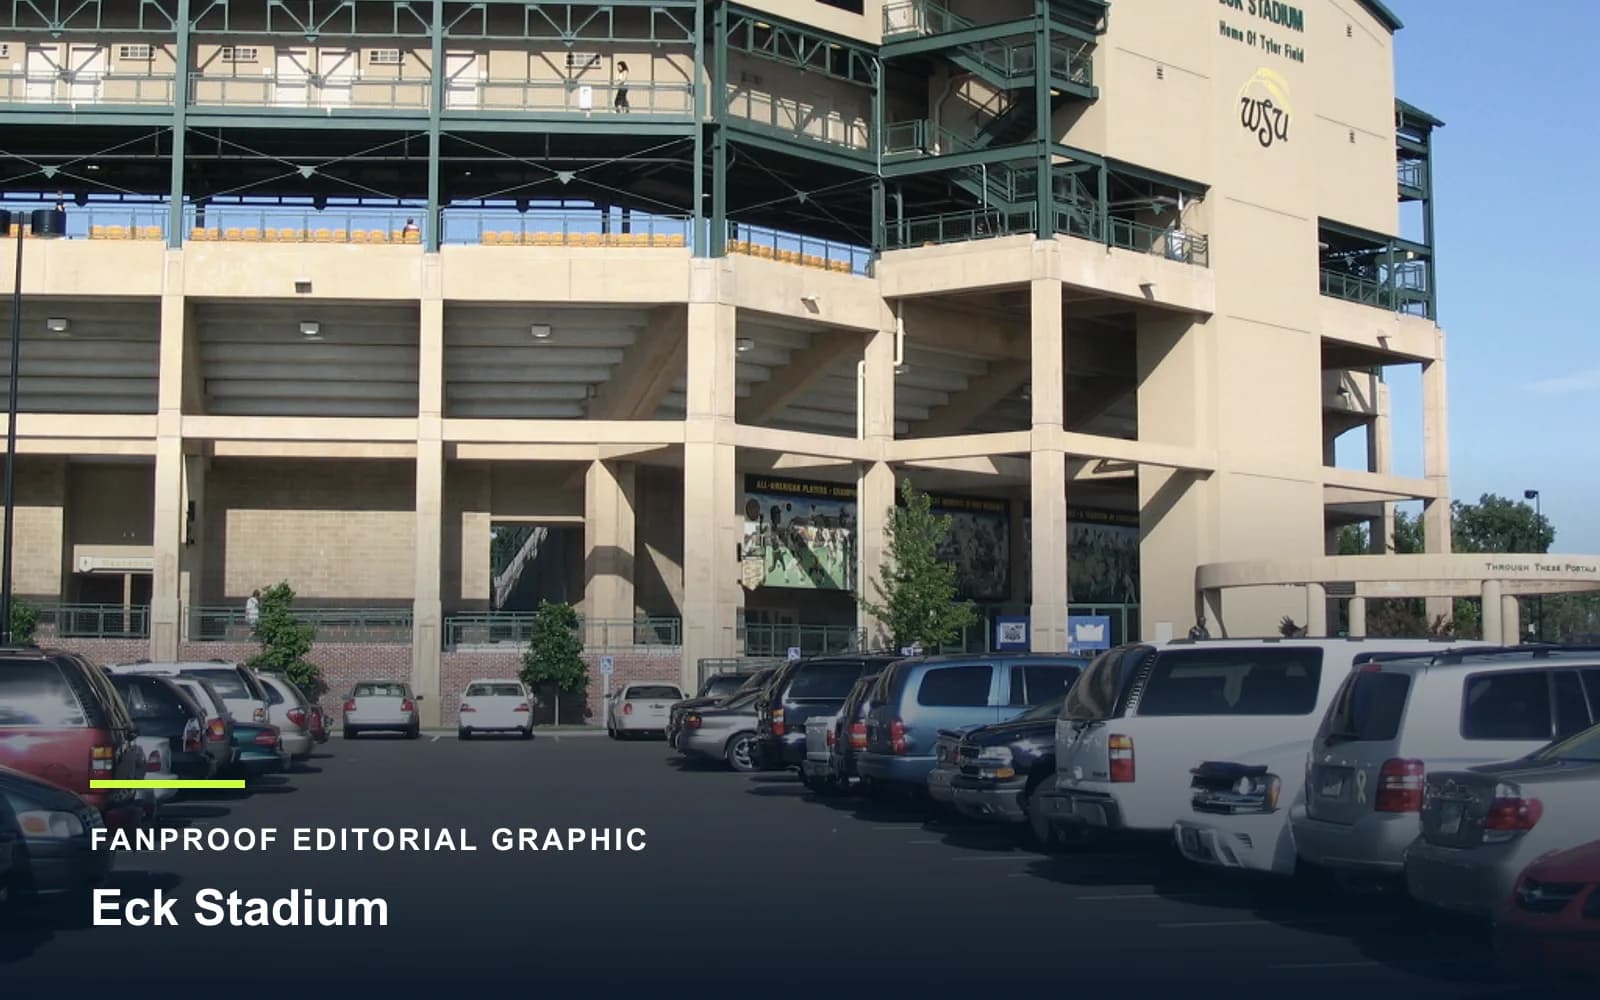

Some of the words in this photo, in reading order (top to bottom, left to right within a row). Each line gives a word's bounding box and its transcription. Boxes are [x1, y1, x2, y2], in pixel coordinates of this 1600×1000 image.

[1248, 0, 1304, 32] STADIUM
[1219, 20, 1244, 42] Home
[1260, 34, 1281, 55] Tyler
[1284, 43, 1304, 63] Field
[1241, 97, 1289, 148] WSU
